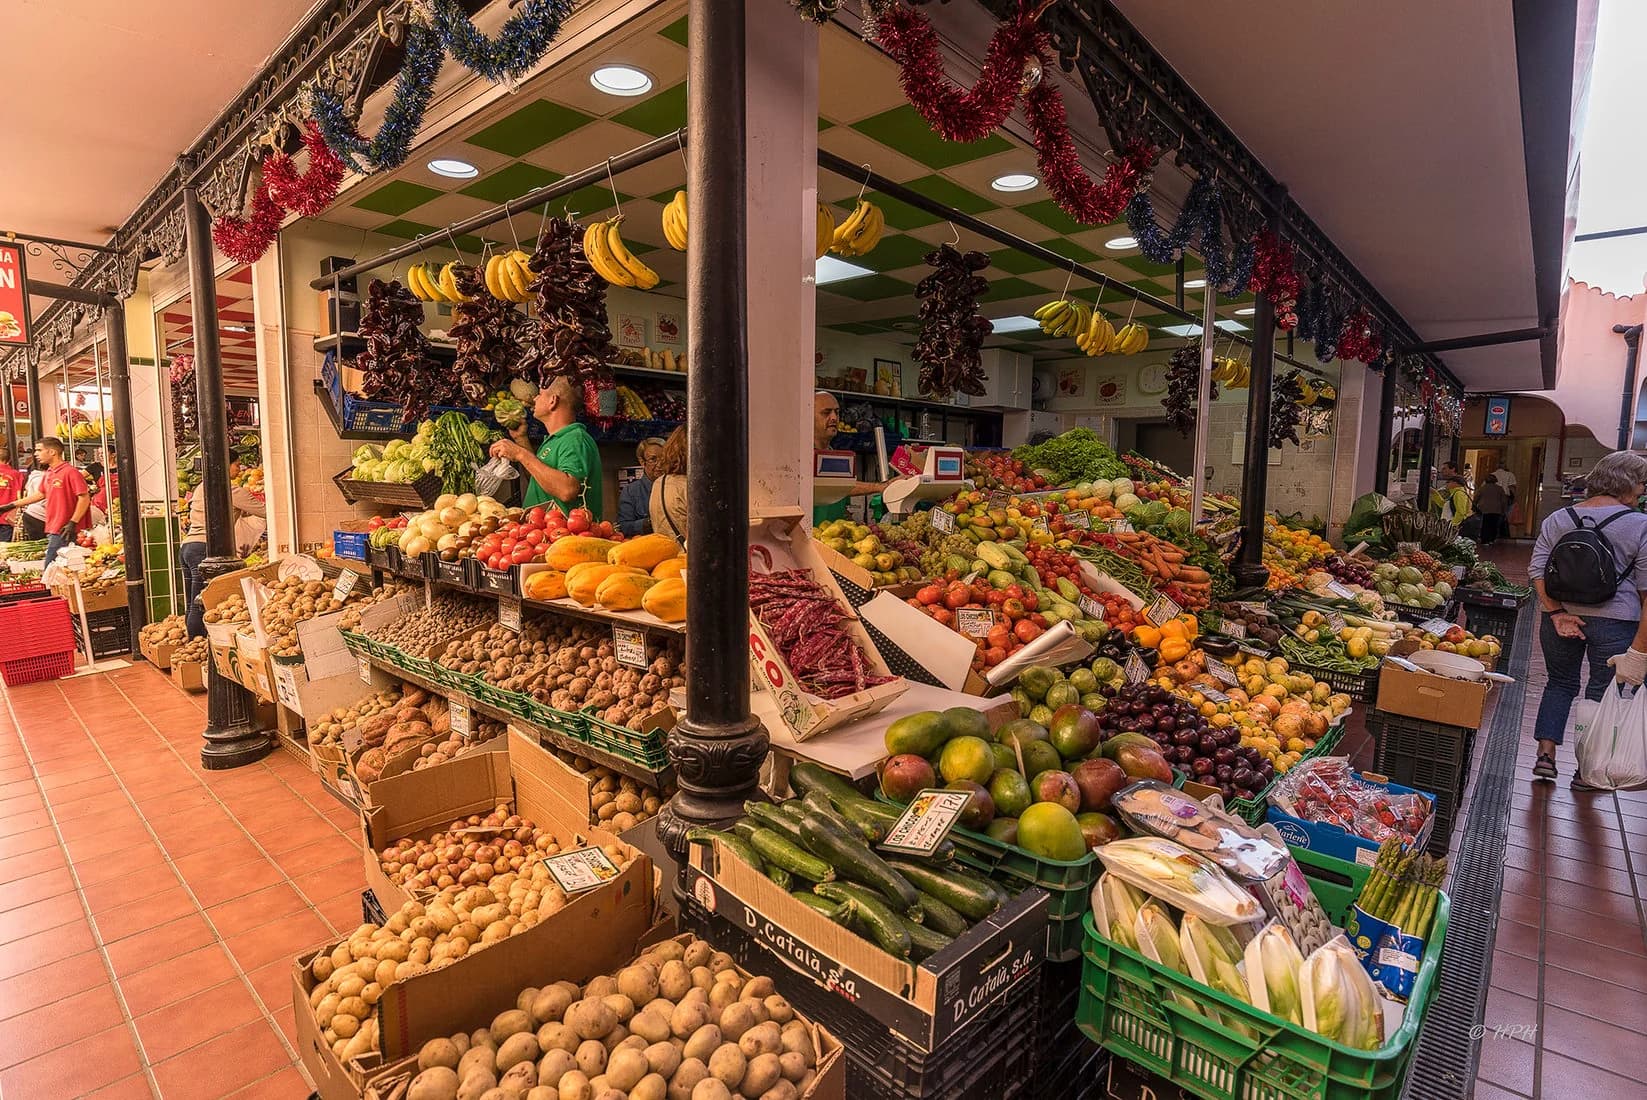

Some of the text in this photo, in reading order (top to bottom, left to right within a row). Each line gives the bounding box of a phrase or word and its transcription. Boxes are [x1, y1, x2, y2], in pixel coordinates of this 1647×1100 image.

[750, 626, 784, 688] GO
[890, 832, 906, 844] LOS
[899, 814, 921, 833] CHICOS
